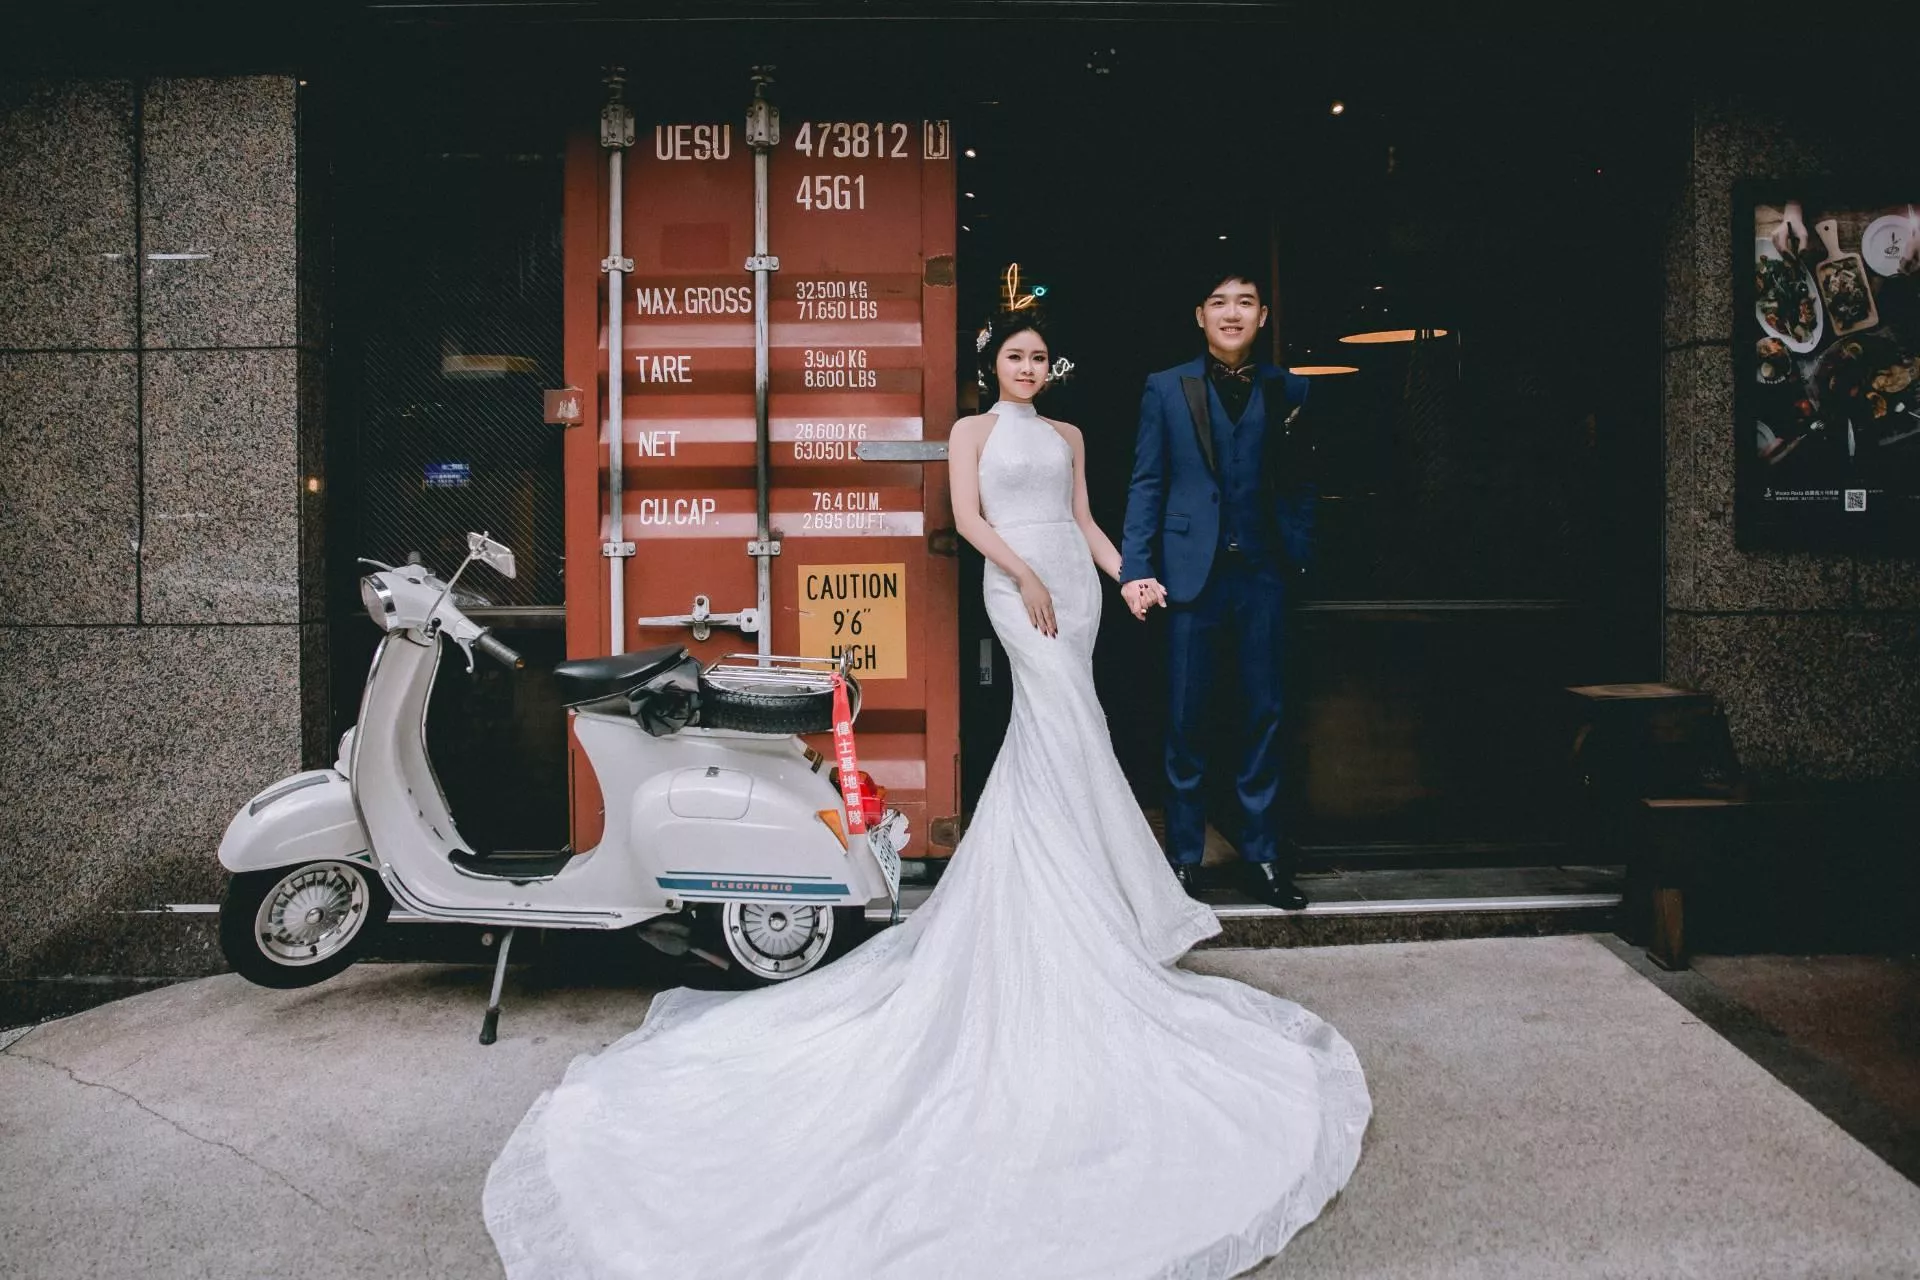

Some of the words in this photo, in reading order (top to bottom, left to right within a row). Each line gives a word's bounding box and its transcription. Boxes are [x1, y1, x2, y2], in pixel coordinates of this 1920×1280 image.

[656, 124, 730, 160] UESU
[794, 122, 908, 158] 473812
[796, 174, 865, 210] 45G1
[849, 281, 868, 299] KG
[850, 301, 877, 319] LBS
[636, 355, 692, 383] TARE
[848, 349, 867, 368] KG
[849, 370, 877, 388] LBS
[848, 423, 867, 440] KG
[638, 431, 680, 457] NET
[640, 498, 719, 525] CU.CAP.
[812, 491, 843, 511] 76.4
[807, 573, 897, 600] CAUTION
[831, 645, 877, 670] HGH
[711, 881, 793, 892] ELECTRONIC
